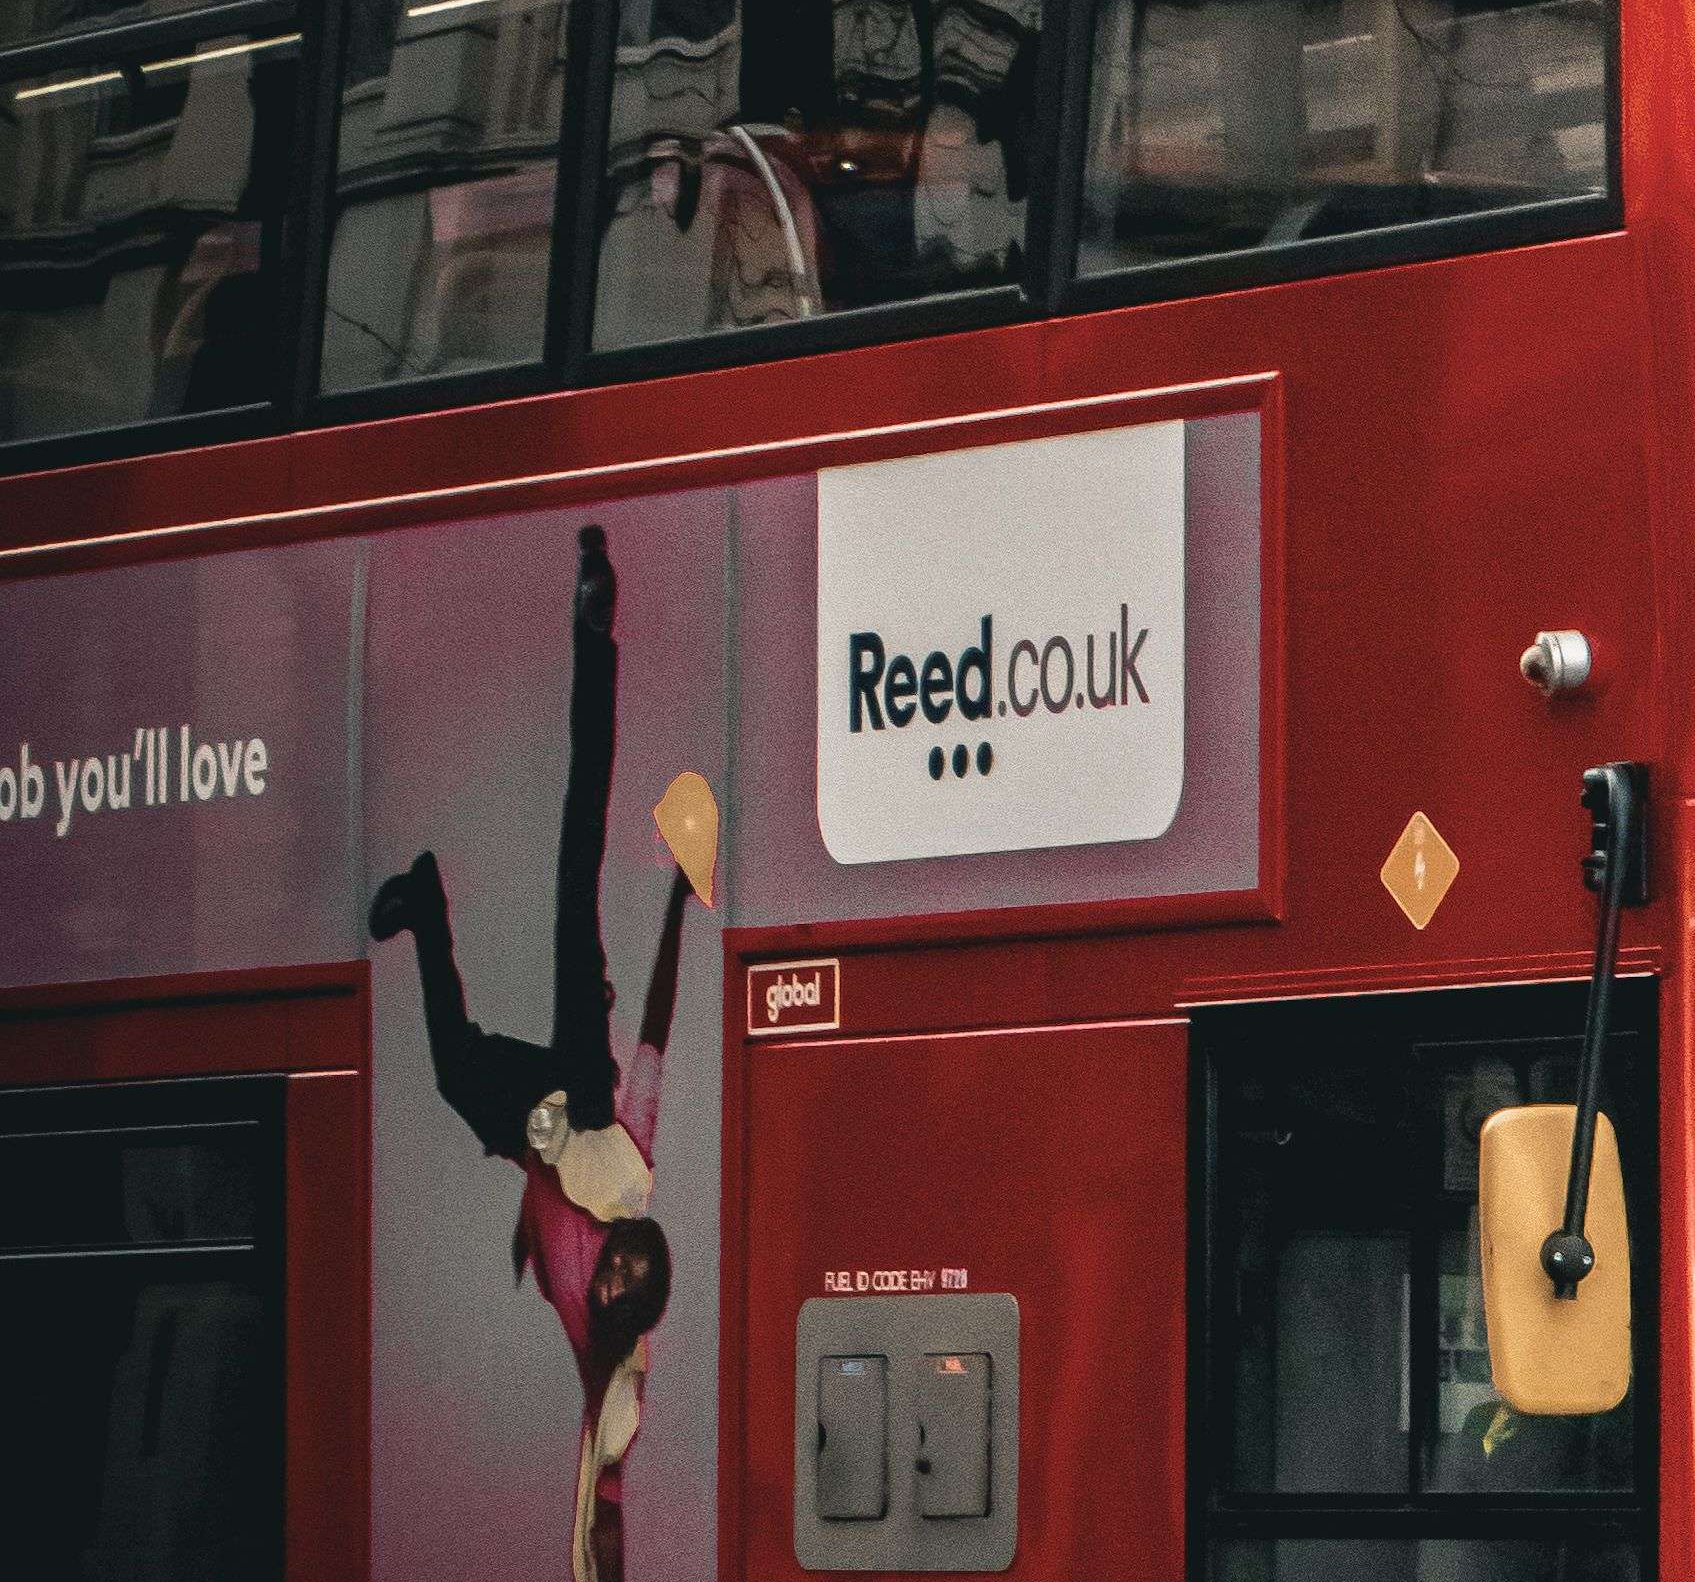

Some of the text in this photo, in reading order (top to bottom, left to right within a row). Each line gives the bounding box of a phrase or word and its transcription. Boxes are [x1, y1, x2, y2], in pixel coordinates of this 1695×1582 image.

[849, 603, 1151, 733] Reed.co.uk
[55, 727, 168, 837] you'll
[179, 724, 268, 802] love
[766, 971, 821, 1023] global
